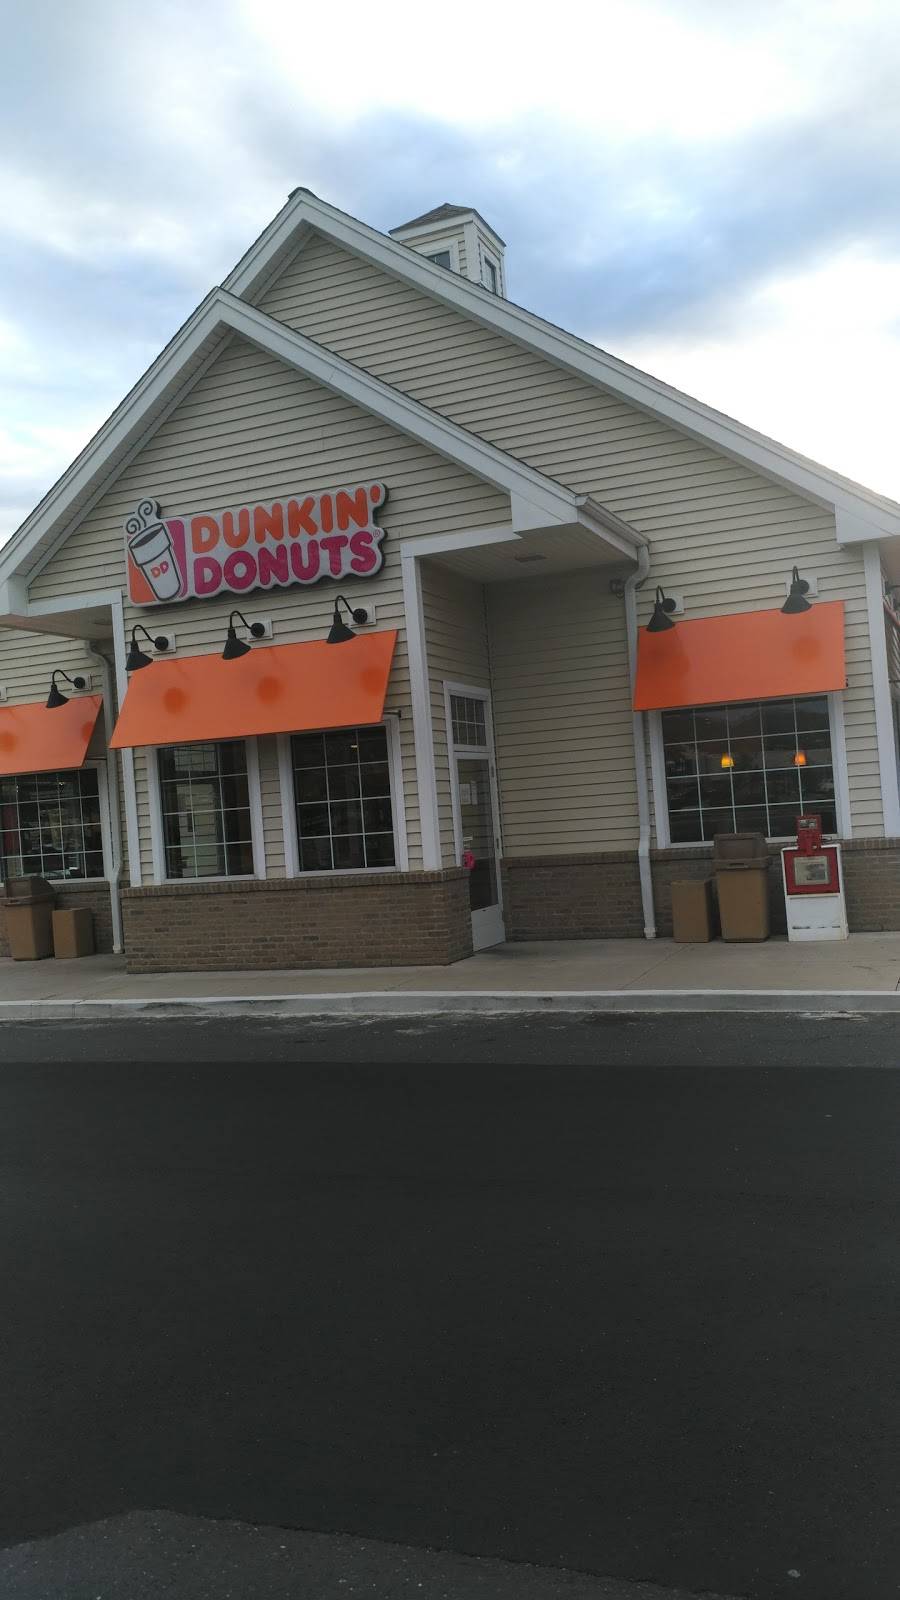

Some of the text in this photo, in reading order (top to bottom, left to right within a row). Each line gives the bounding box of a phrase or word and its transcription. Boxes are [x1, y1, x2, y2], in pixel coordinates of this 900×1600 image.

[191, 484, 381, 554] DUNKIN'
[151, 560, 169, 578] DD
[193, 530, 378, 595] DONUTS
